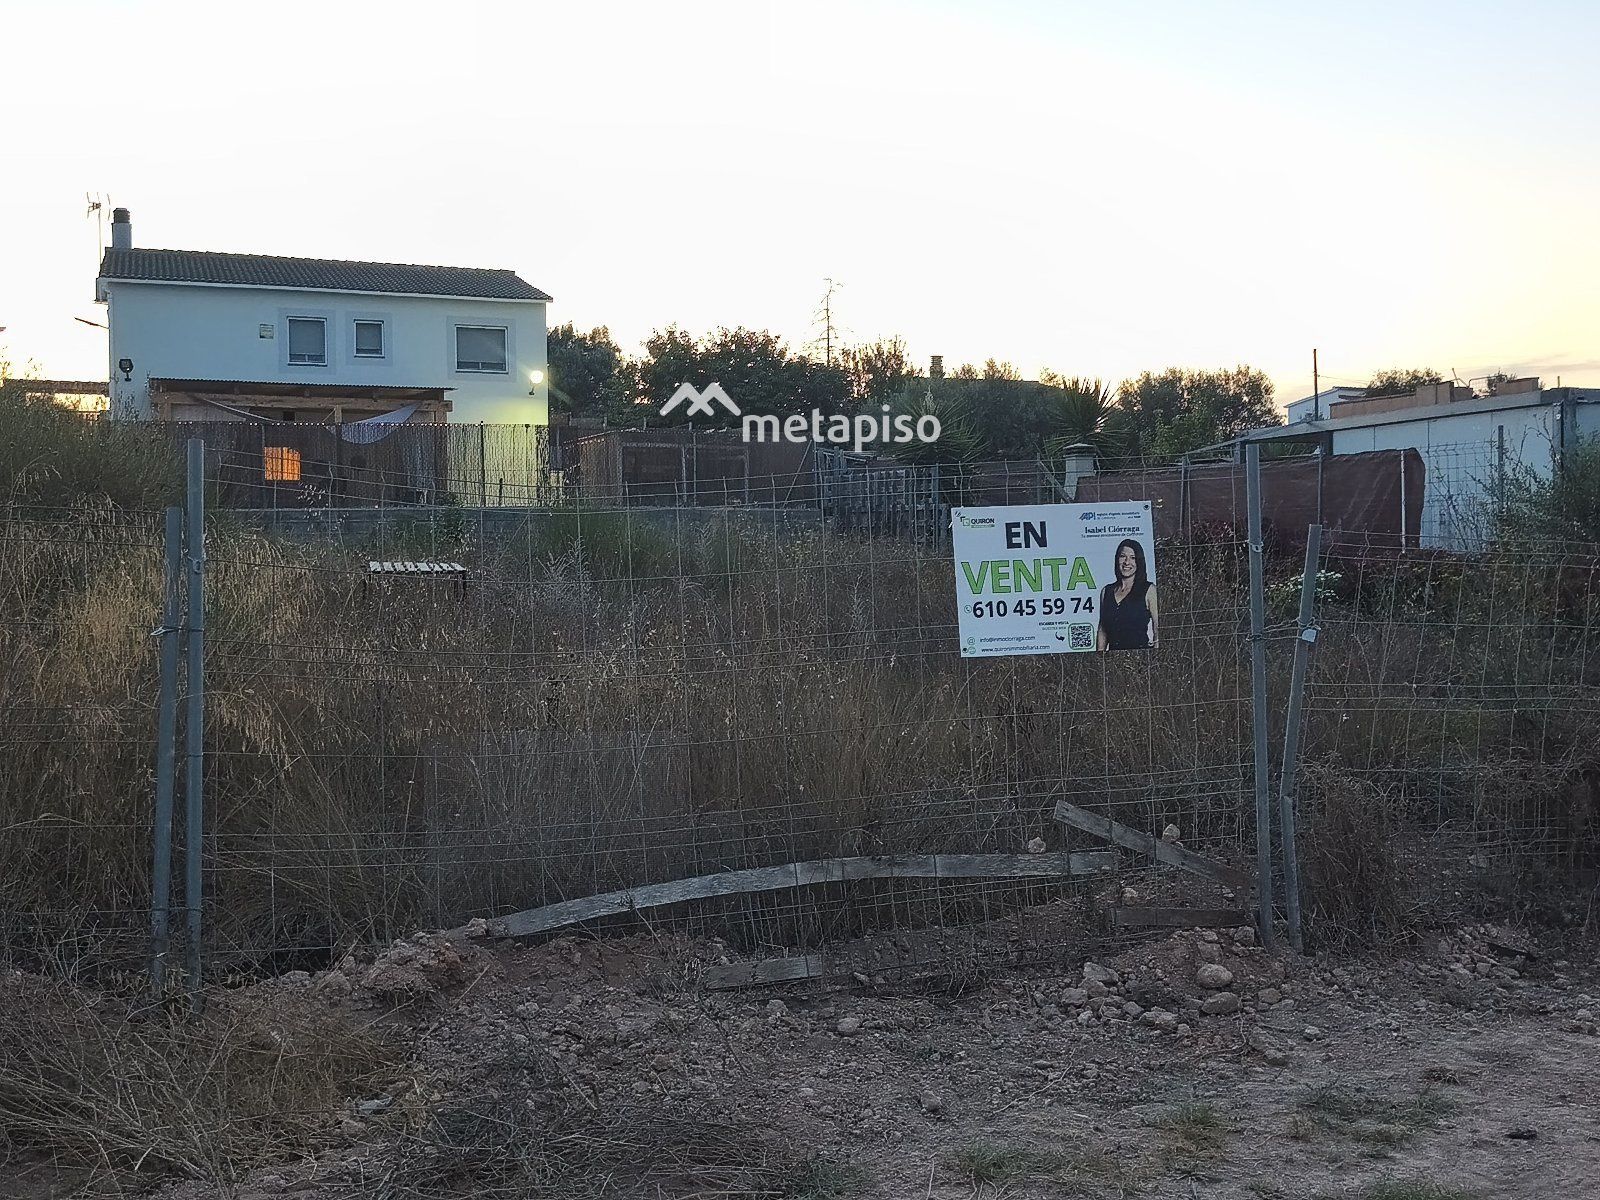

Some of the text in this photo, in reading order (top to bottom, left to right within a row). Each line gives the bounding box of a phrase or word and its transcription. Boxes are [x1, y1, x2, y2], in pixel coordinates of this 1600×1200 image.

[1005, 521, 1048, 549] EN
[961, 557, 1096, 594] VENTA
[972, 597, 1094, 618] 610 45 59 74
